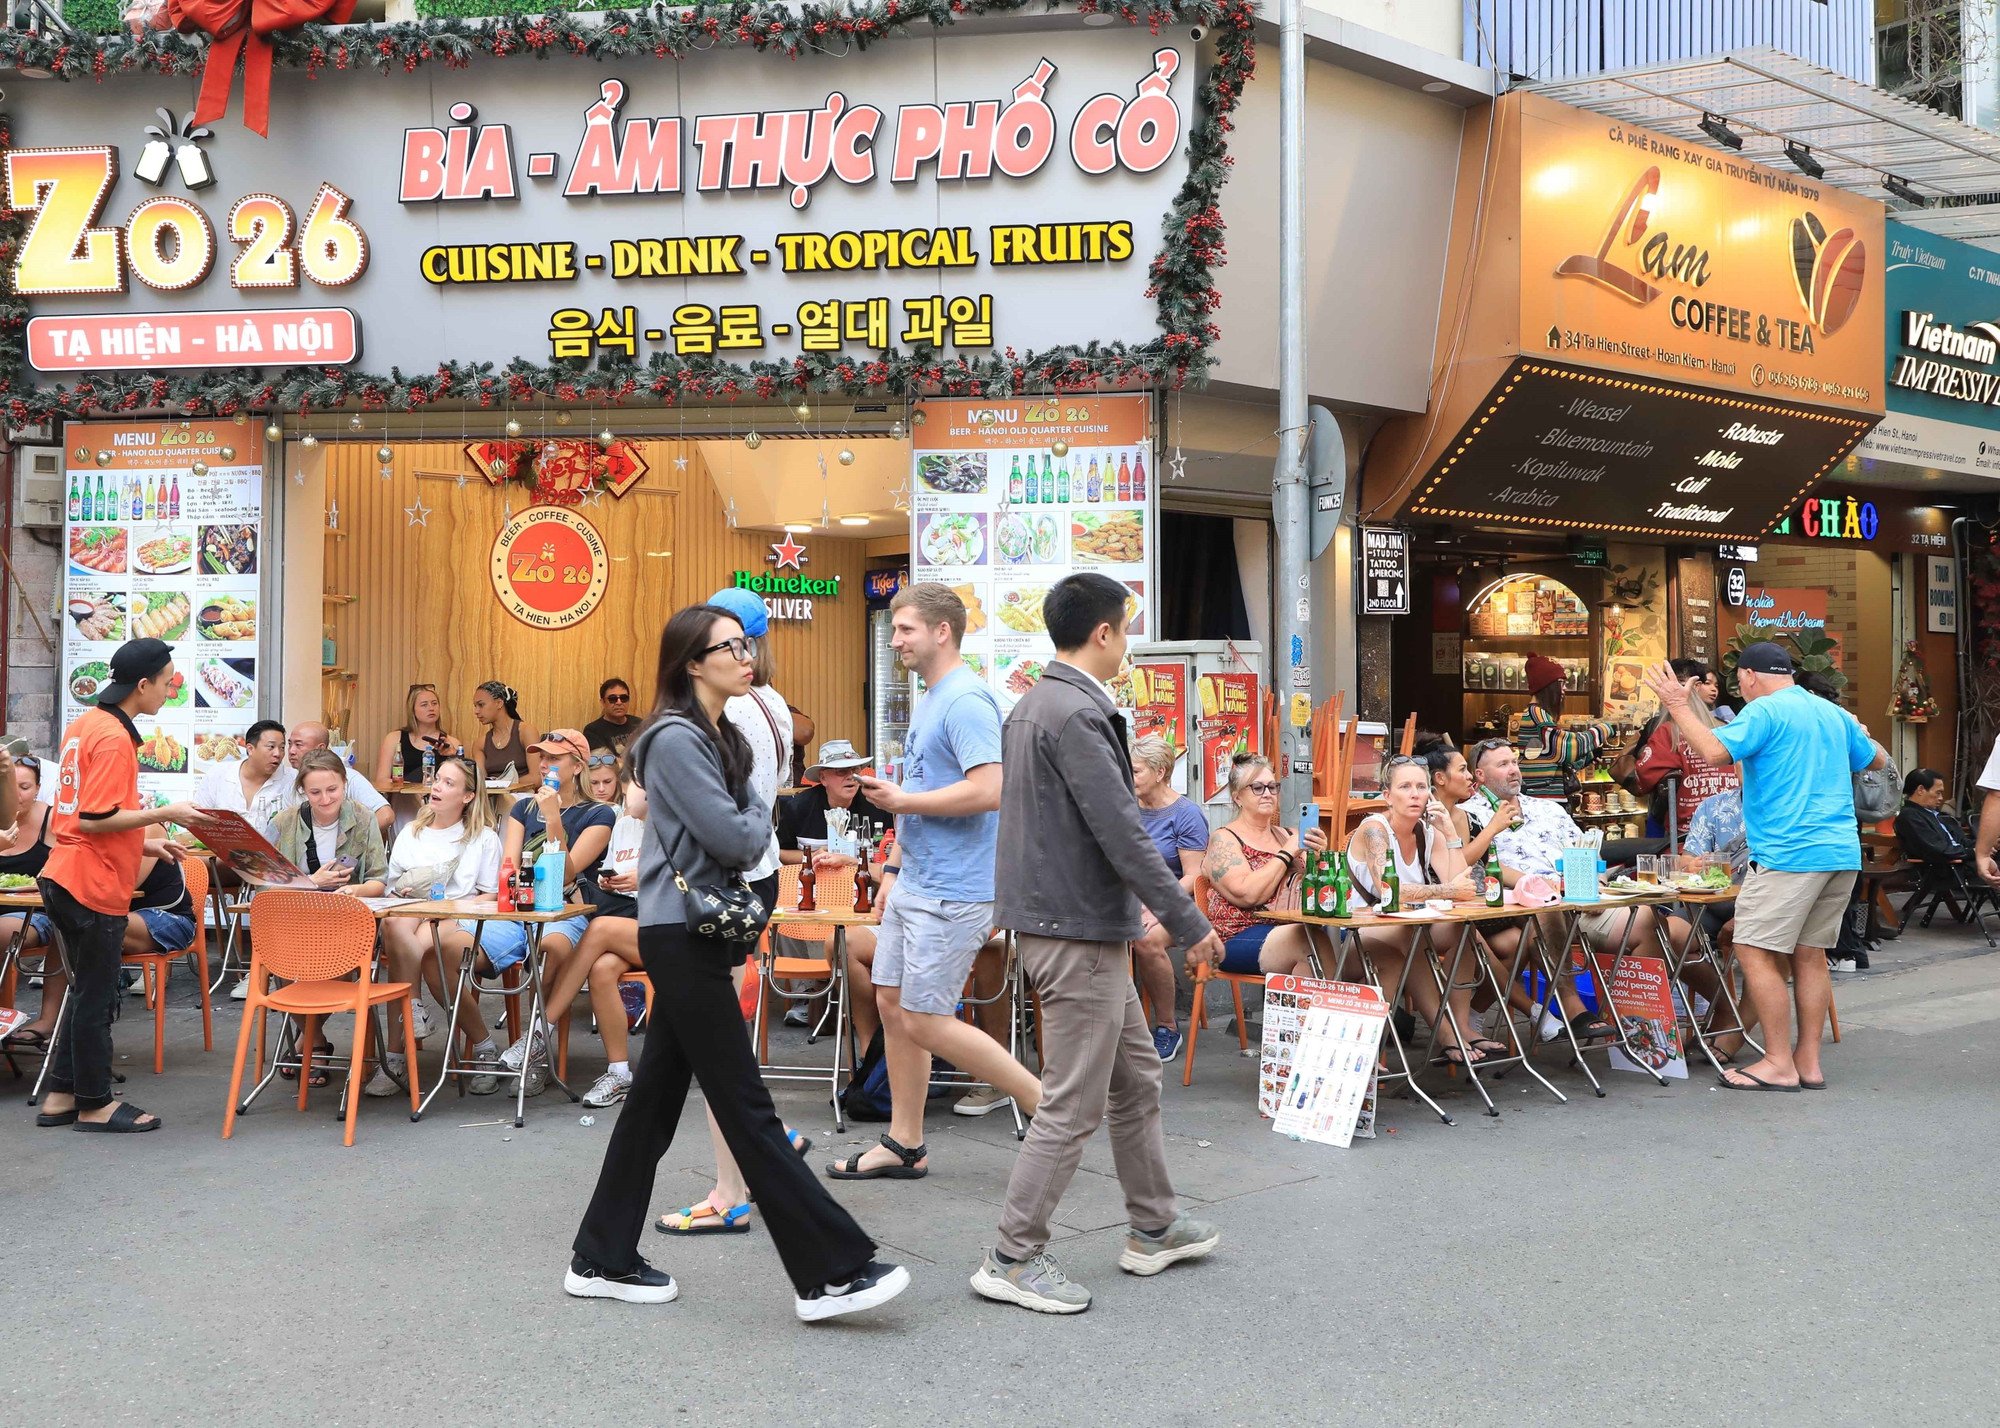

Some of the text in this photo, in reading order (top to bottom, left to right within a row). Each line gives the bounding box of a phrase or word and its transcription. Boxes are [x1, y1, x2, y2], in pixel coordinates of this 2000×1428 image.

[563, 78, 685, 197] ẨM
[695, 92, 885, 210] THỰC
[891, 57, 1057, 183] PHỐ
[1071, 47, 1181, 175] CỔ
[1609, 126, 1624, 144] CÀ
[1627, 134, 1648, 151] PHÊ
[1651, 140, 1680, 160] RANG
[1684, 150, 1702, 167] XAY
[1706, 157, 1723, 173] GIA
[1764, 172, 1776, 189] TỪ
[1778, 177, 1798, 196] NĂM
[1800, 185, 1819, 201] 1979
[227, 182, 370, 287] 26
[421, 221, 1134, 284] CUISINE DRINK TROPICAL FRUITS
[1891, 240, 1946, 270] Truly Vietnam
[1968, 266, 1986, 281] C.TY
[548, 295, 993, 359] 음식 음료 열대 과일
[1670, 295, 1815, 355] COFFEE & TEA
[49, 318, 333, 361] TẠ HIỆN HÀ NỘI
[1905, 311, 1997, 365] Vietnam
[1564, 330, 1736, 375] 34 Ta Hien Street Hoan Kiem Hanoi
[1066, 406, 1090, 422] 26
[1567, 397, 1631, 423] Weasel
[114, 433, 155, 446] MENU
[195, 430, 216, 444] 26
[950, 424, 1109, 436] BEER HANOI OLD QUARTER CUISINE
[1722, 422, 1784, 446] Robusta
[1878, 426, 1891, 437] Hien
[1901, 430, 1917, 442] Hanoi
[122, 449, 147, 458] HANOI
[149, 448, 165, 457] OLD
[166, 448, 200, 457] QUARTER
[1541, 428, 1654, 458] Bluemountain
[1876, 442, 1966, 464] www.vietnamimpressivetravel.com
[1517, 458, 1606, 483] Kopiluwak
[1698, 450, 1744, 470] Moka
[1676, 477, 1711, 494] Culi
[1318, 492, 1341, 511] FUNK25
[1494, 486, 1560, 507] Arabica
[1653, 502, 1733, 524] Traditional
[1802, 495, 1879, 541] CHÀO
[500, 511, 603, 557] BEER COFFEE CUSINE
[1911, 533, 1946, 548] 32 TẠ HIỆN
[1370, 560, 1397, 568] TATTOO
[563, 566, 591, 584] 26
[734, 570, 839, 596] Heineken
[871, 573, 895, 596] Tiger
[1730, 574, 1743, 590] 32
[1369, 598, 1396, 608] 2ND FLOOR
[1930, 589, 1954, 607] BOOKING
[512, 600, 592, 625] TA HIEN HA NOI
[763, 598, 812, 620] SILVER
[1798, 611, 1825, 628] Cream
[1226, 700, 1247, 714] VÀNG
[1629, 961, 1642, 969] 26
[1630, 982, 1658, 990] person
[1638, 971, 1662, 985] BBQ
[1346, 985, 1360, 994] HIỆN
